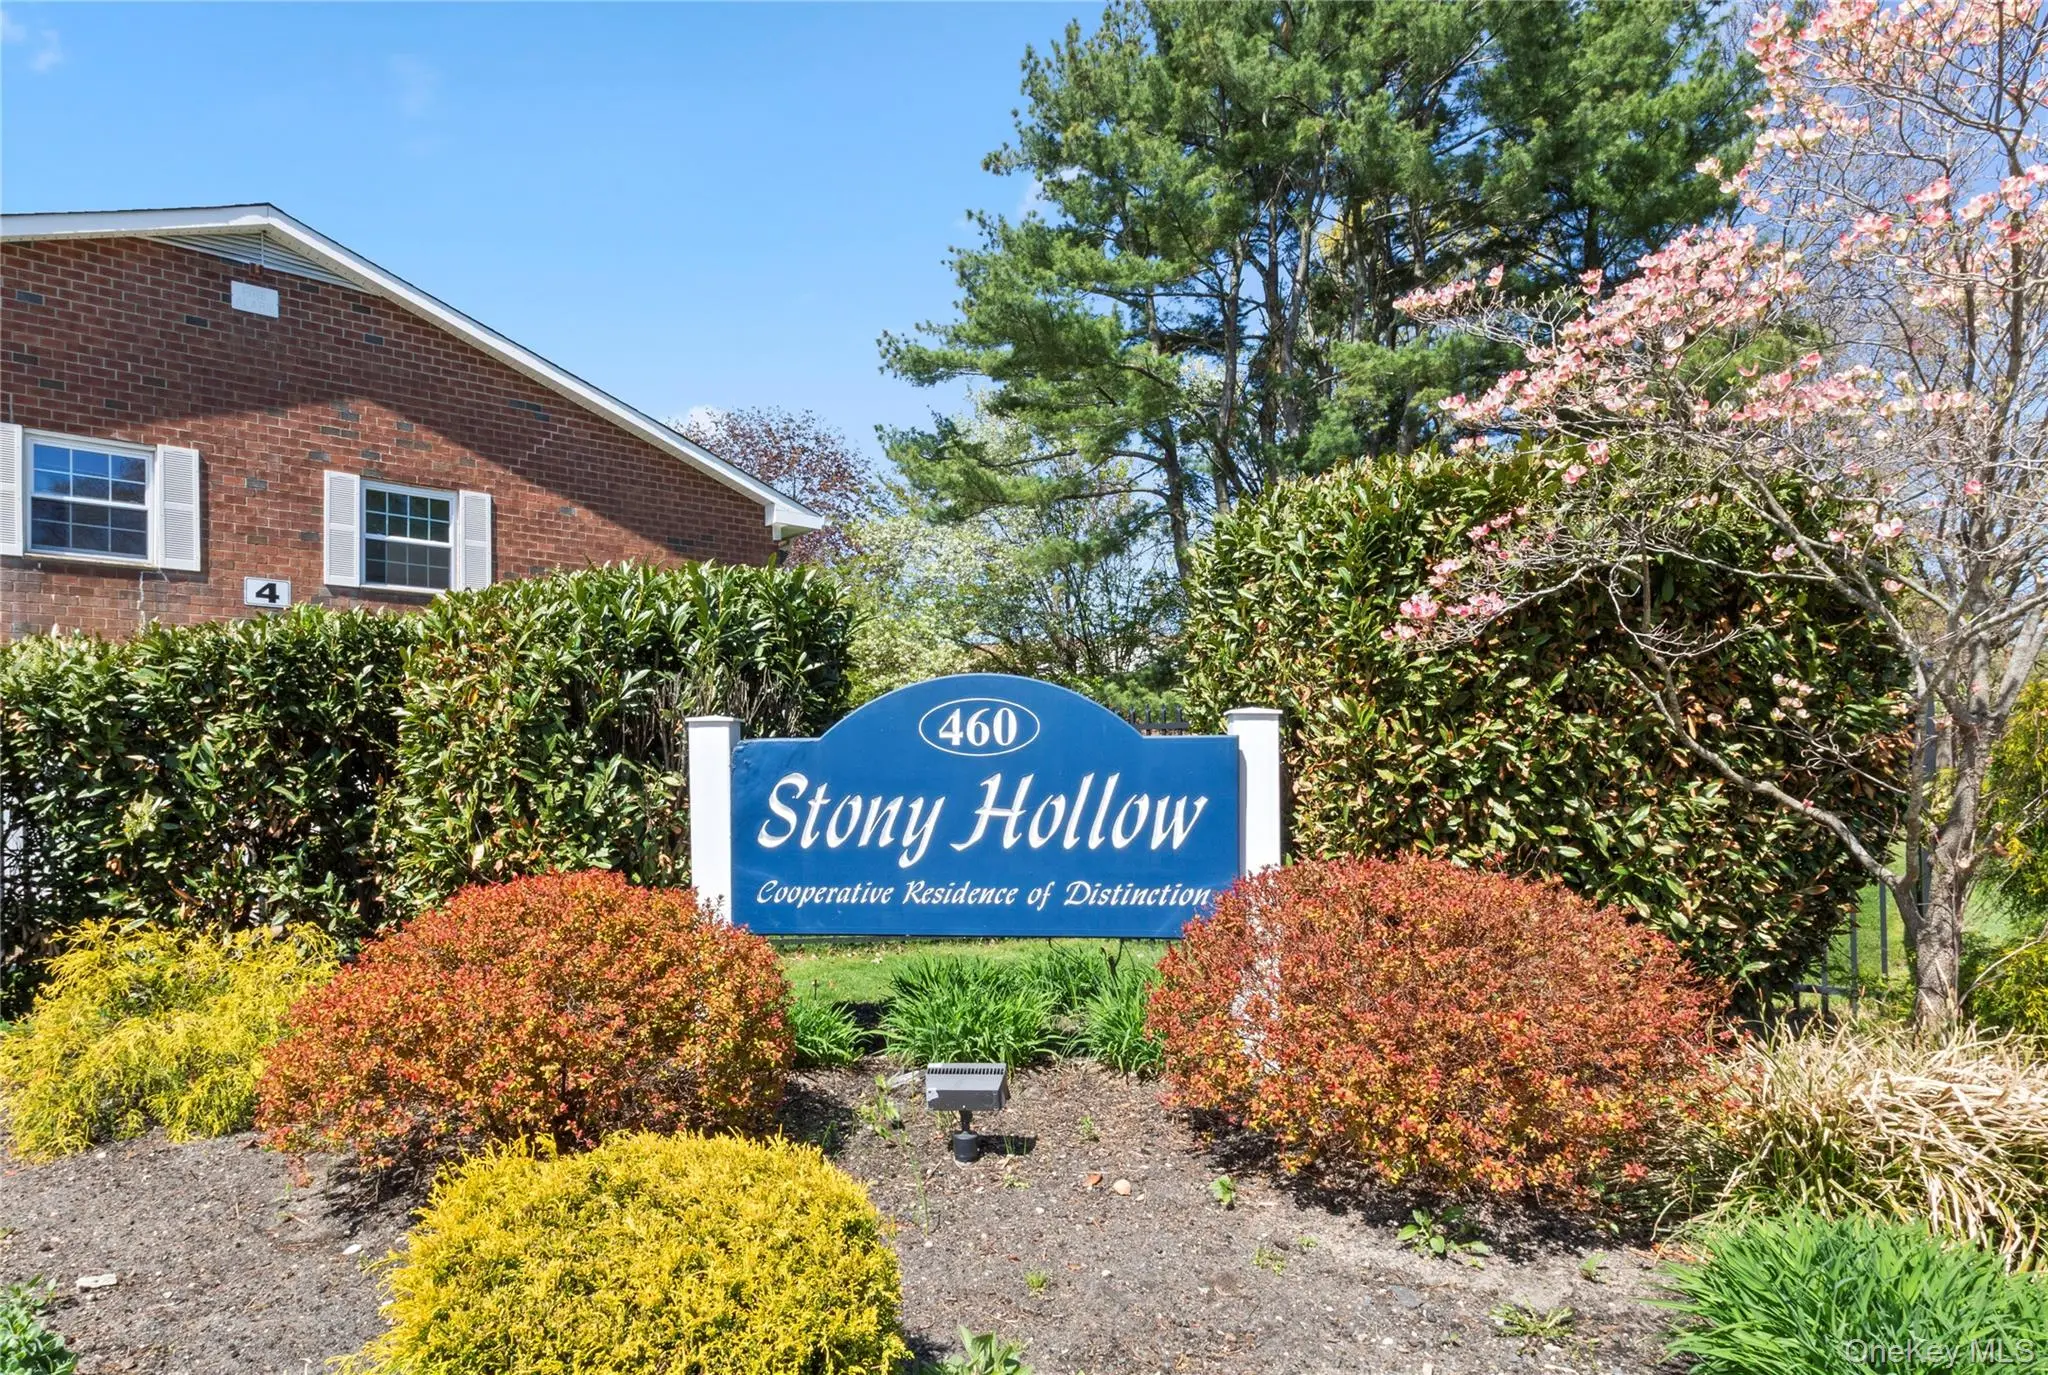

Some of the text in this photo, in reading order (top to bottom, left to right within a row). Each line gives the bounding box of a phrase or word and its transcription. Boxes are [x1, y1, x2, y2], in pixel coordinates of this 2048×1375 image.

[255, 582, 280, 604] 4
[938, 707, 1018, 747] 460
[756, 772, 1209, 869] Stony Hollow
[756, 879, 1212, 911] Cooperative Residence of Distinction
